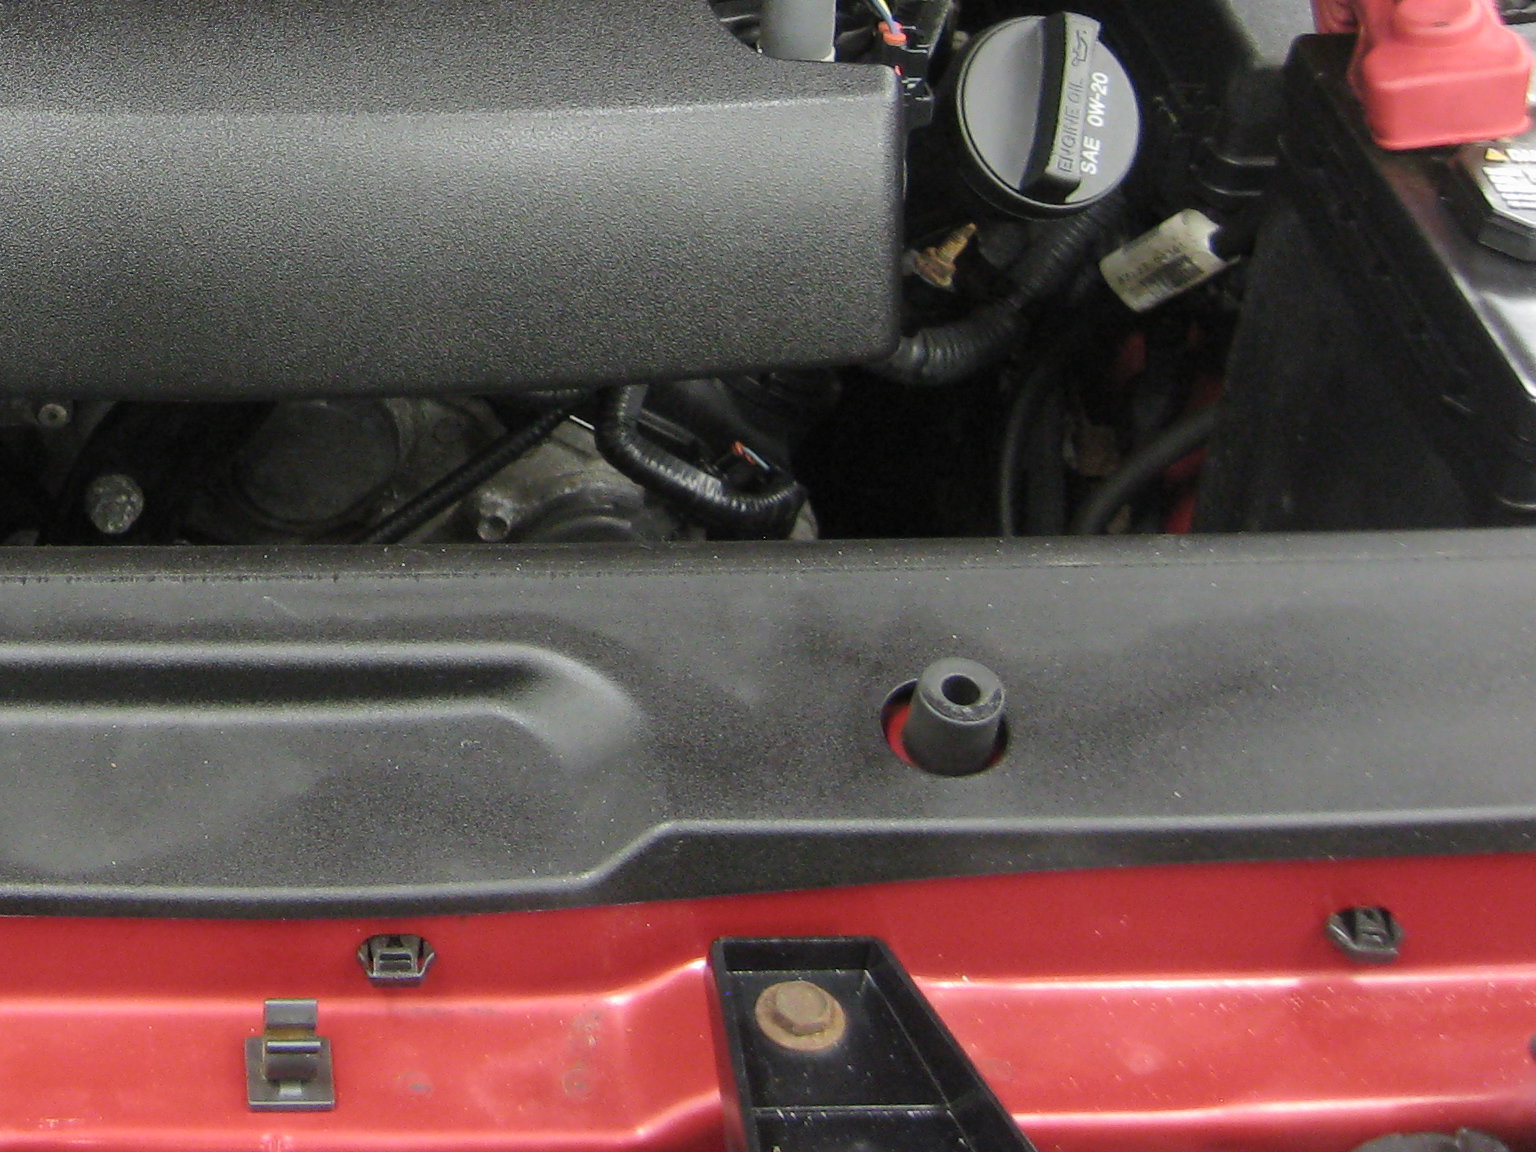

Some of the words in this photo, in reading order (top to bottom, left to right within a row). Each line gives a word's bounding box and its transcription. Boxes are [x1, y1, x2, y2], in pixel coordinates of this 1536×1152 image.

[1067, 78, 1084, 104] OIL
[1087, 71, 1109, 128] 0W-20
[1057, 105, 1080, 173] ENGINE
[1081, 136, 1101, 175] SAE
